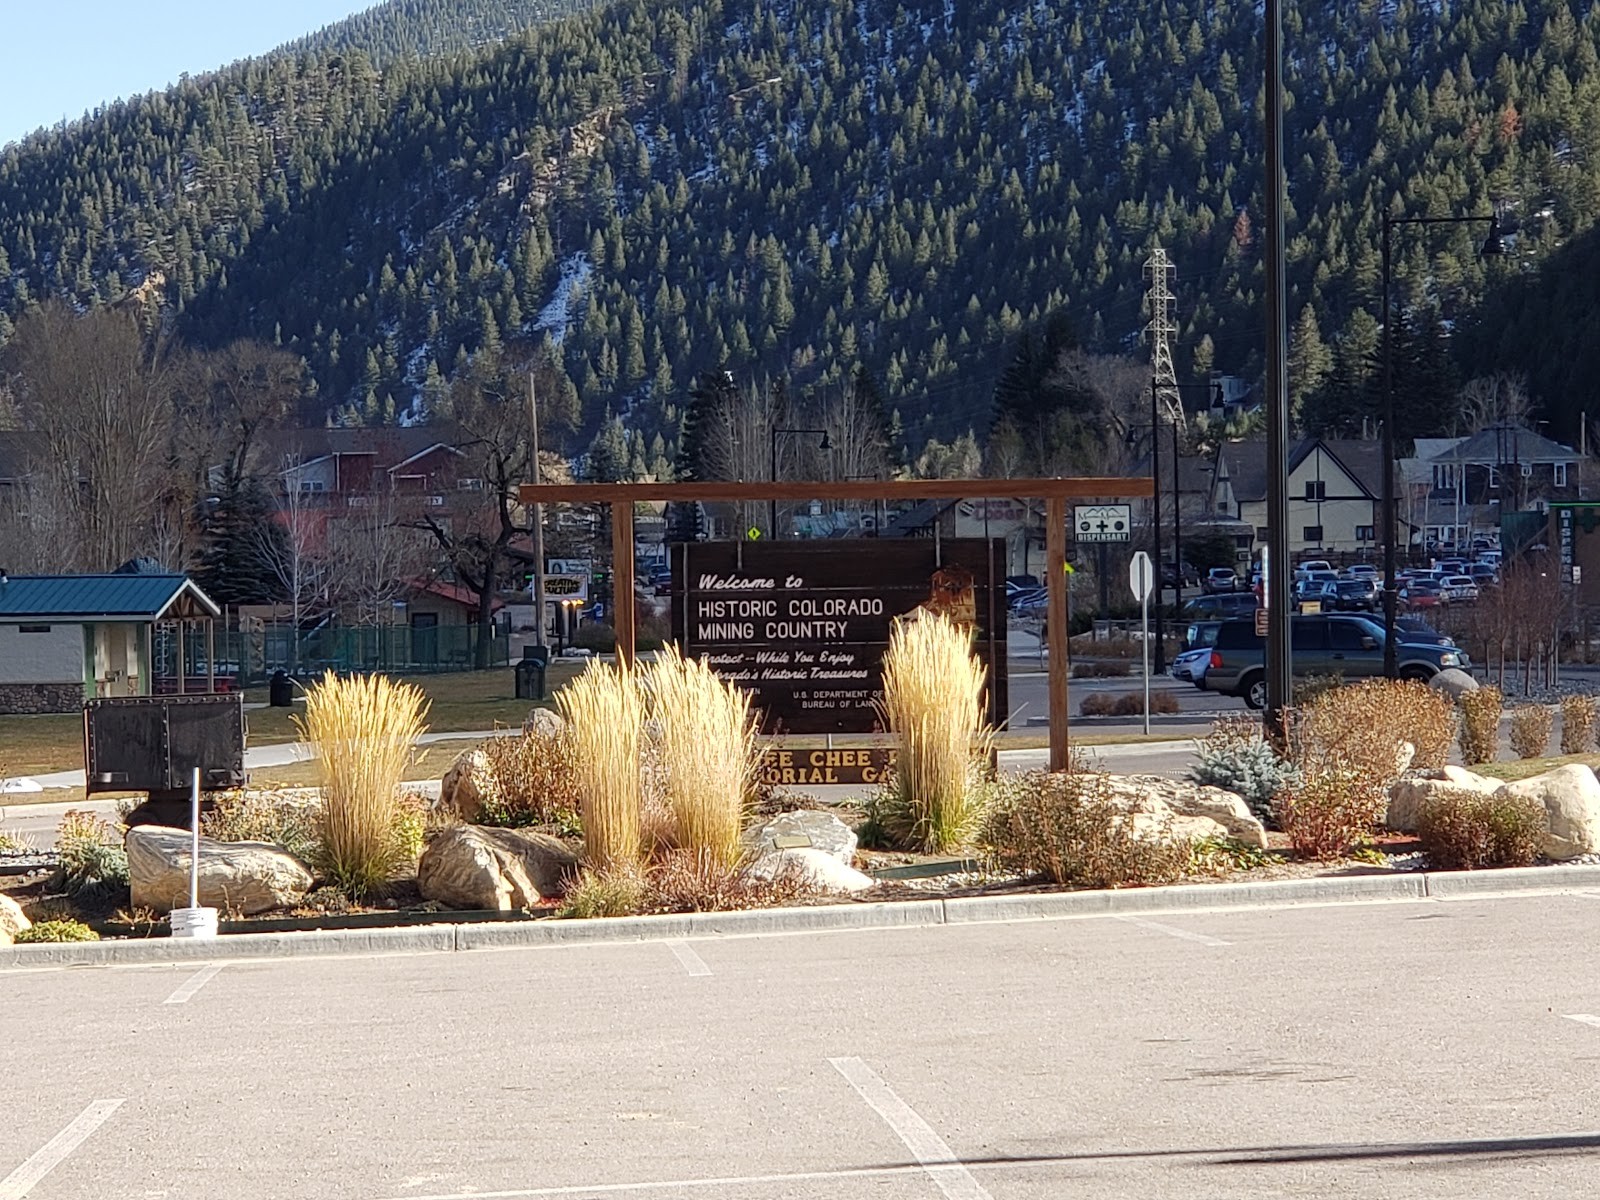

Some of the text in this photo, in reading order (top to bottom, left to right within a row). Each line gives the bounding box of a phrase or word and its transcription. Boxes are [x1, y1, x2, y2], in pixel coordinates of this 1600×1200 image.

[1077, 533, 1127, 541] DISPENSARY
[699, 573, 804, 590] Welcome to
[698, 598, 883, 618] HISTORIC COLORADO
[698, 620, 848, 640] MINING COUNTRY
[755, 650, 790, 664] While
[794, 650, 814, 664] You
[819, 650, 855, 666] Enjoy
[761, 667, 808, 681] Historic
[810, 666, 869, 680] Treasures
[813, 689, 869, 699] DEPARTMENT
[872, 689, 884, 699] OF
[802, 699, 835, 709] BUREAU
[839, 699, 850, 708] OF
[809, 750, 871, 767] CHEE
